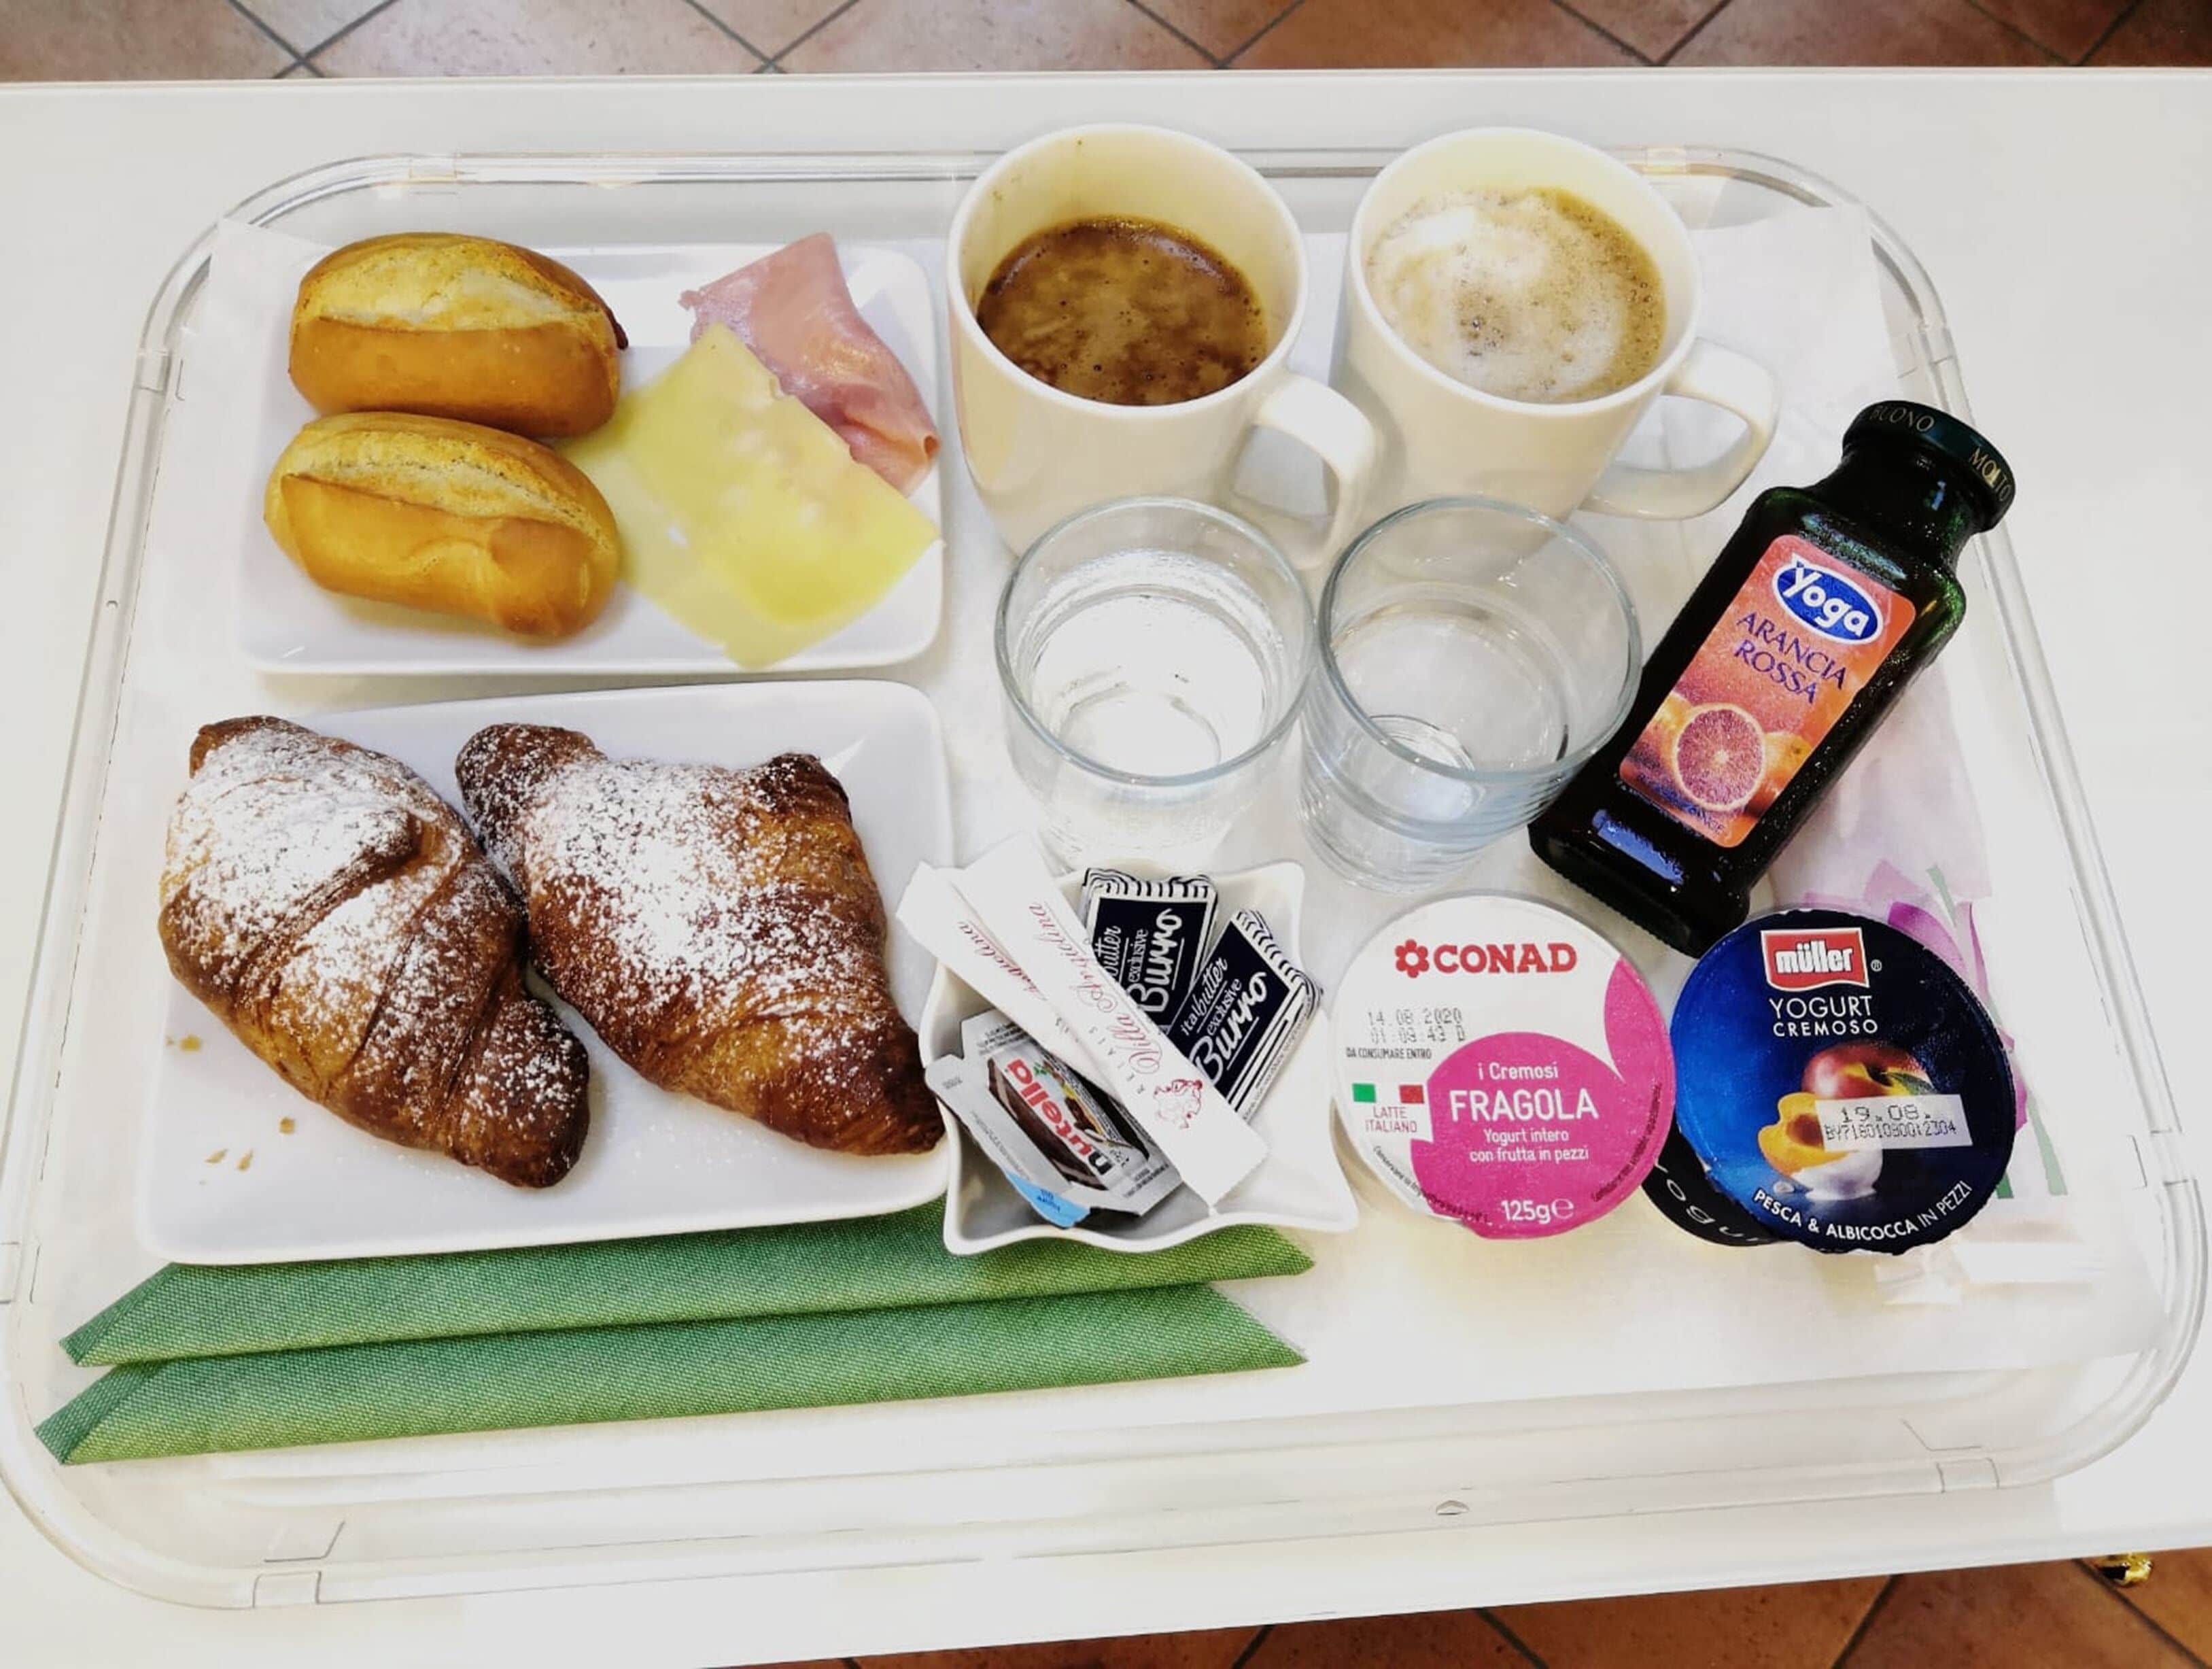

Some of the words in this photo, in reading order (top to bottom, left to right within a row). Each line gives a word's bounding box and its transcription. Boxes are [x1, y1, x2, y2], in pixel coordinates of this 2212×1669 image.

[1970, 445, 2013, 502] MOLTO
[1782, 566, 1869, 638] Yoga
[1736, 612, 1846, 690] ARANCIA
[1734, 639, 1817, 704] ROSSA
[1125, 908, 1183, 1013] Burro
[1128, 928, 1149, 983] exclusive
[1433, 942, 1577, 974] CONAD
[1774, 939, 1854, 974] müller
[1207, 978, 1243, 1037] exclusive
[1768, 994, 1873, 1020] YOGURT
[1189, 971, 1268, 1086] Burro
[1772, 1018, 1879, 1037] CREMOSO
[1346, 1046, 1357, 1058] DA
[1358, 1047, 1404, 1060] CONSUMARE
[1406, 1048, 1432, 1060] ENTRO
[1477, 1063, 1484, 1080] i
[1489, 1061, 1559, 1080] Cremosi
[1007, 1058, 1113, 1175] nutella
[1372, 1106, 1408, 1119] LATTE
[1449, 1088, 1600, 1122] FRAGOLA
[1365, 1119, 1418, 1133] ITALIANO
[1483, 1128, 1527, 1146] Yogurt
[1530, 1128, 1570, 1143] intero
[1469, 1149, 1494, 1163] con
[1496, 1147, 1536, 1163] frutta
[1538, 1148, 1552, 1161] in
[1554, 1145, 1589, 1164] pezzi
[1753, 1189, 1802, 1228] PESCA
[1808, 1218, 1820, 1233] &
[1825, 1218, 1919, 1241] ALBICOCCA
[1916, 1209, 1939, 1228] IN
[1935, 1180, 1973, 1217] PEZZI
